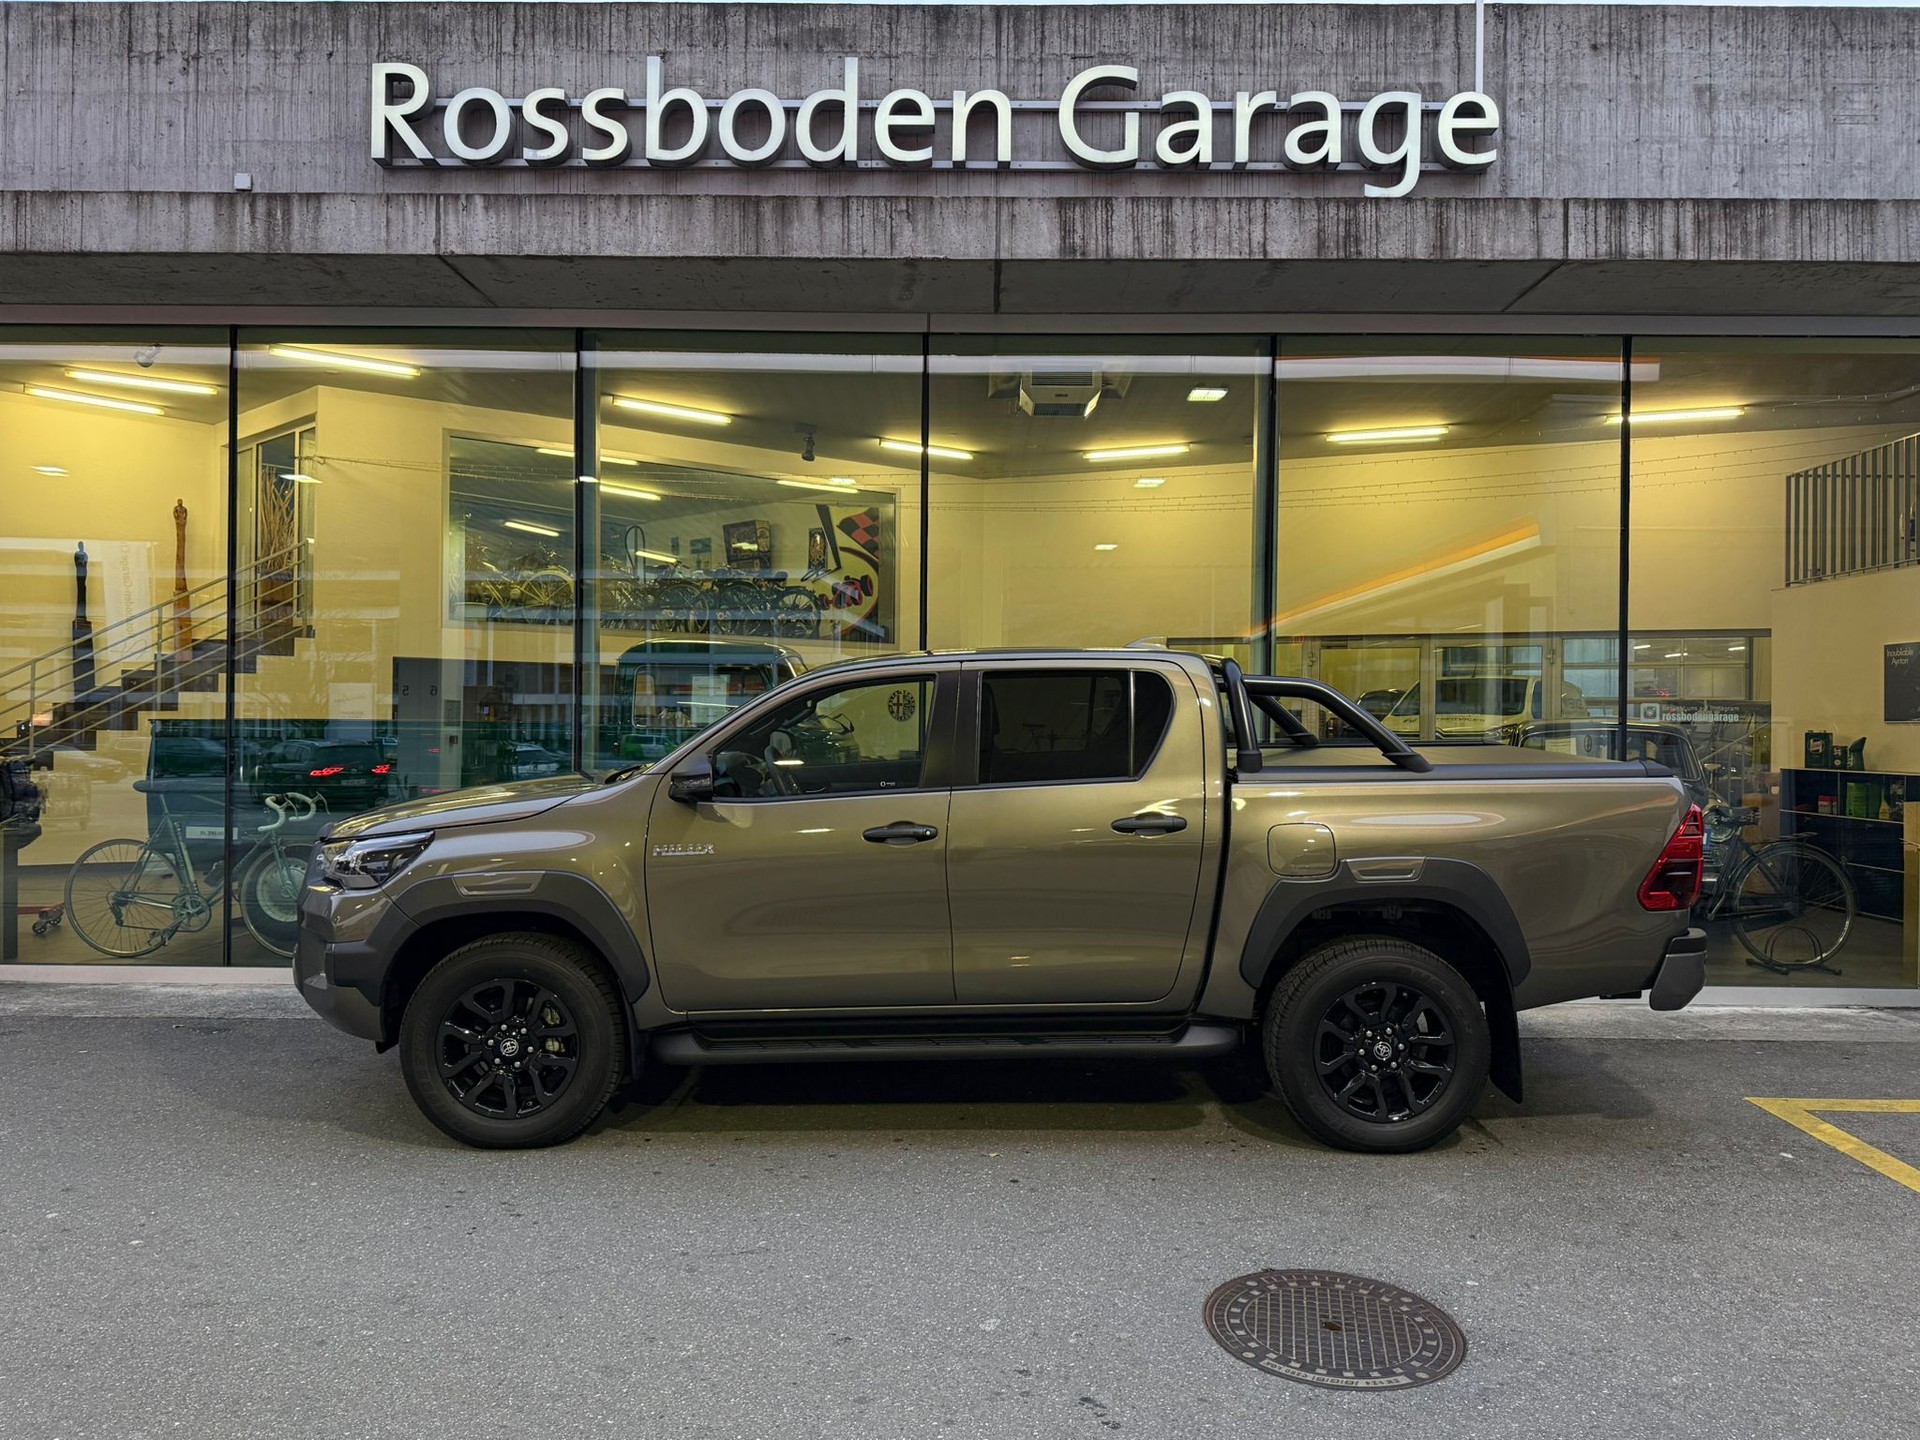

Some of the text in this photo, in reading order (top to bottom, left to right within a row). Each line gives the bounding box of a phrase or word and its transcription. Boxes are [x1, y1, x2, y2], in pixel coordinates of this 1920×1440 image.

[371, 56, 1499, 198] Rossboden Garage
[1890, 657, 1909, 668] Ayrton
[1662, 711, 1740, 722] rossbodengarage
